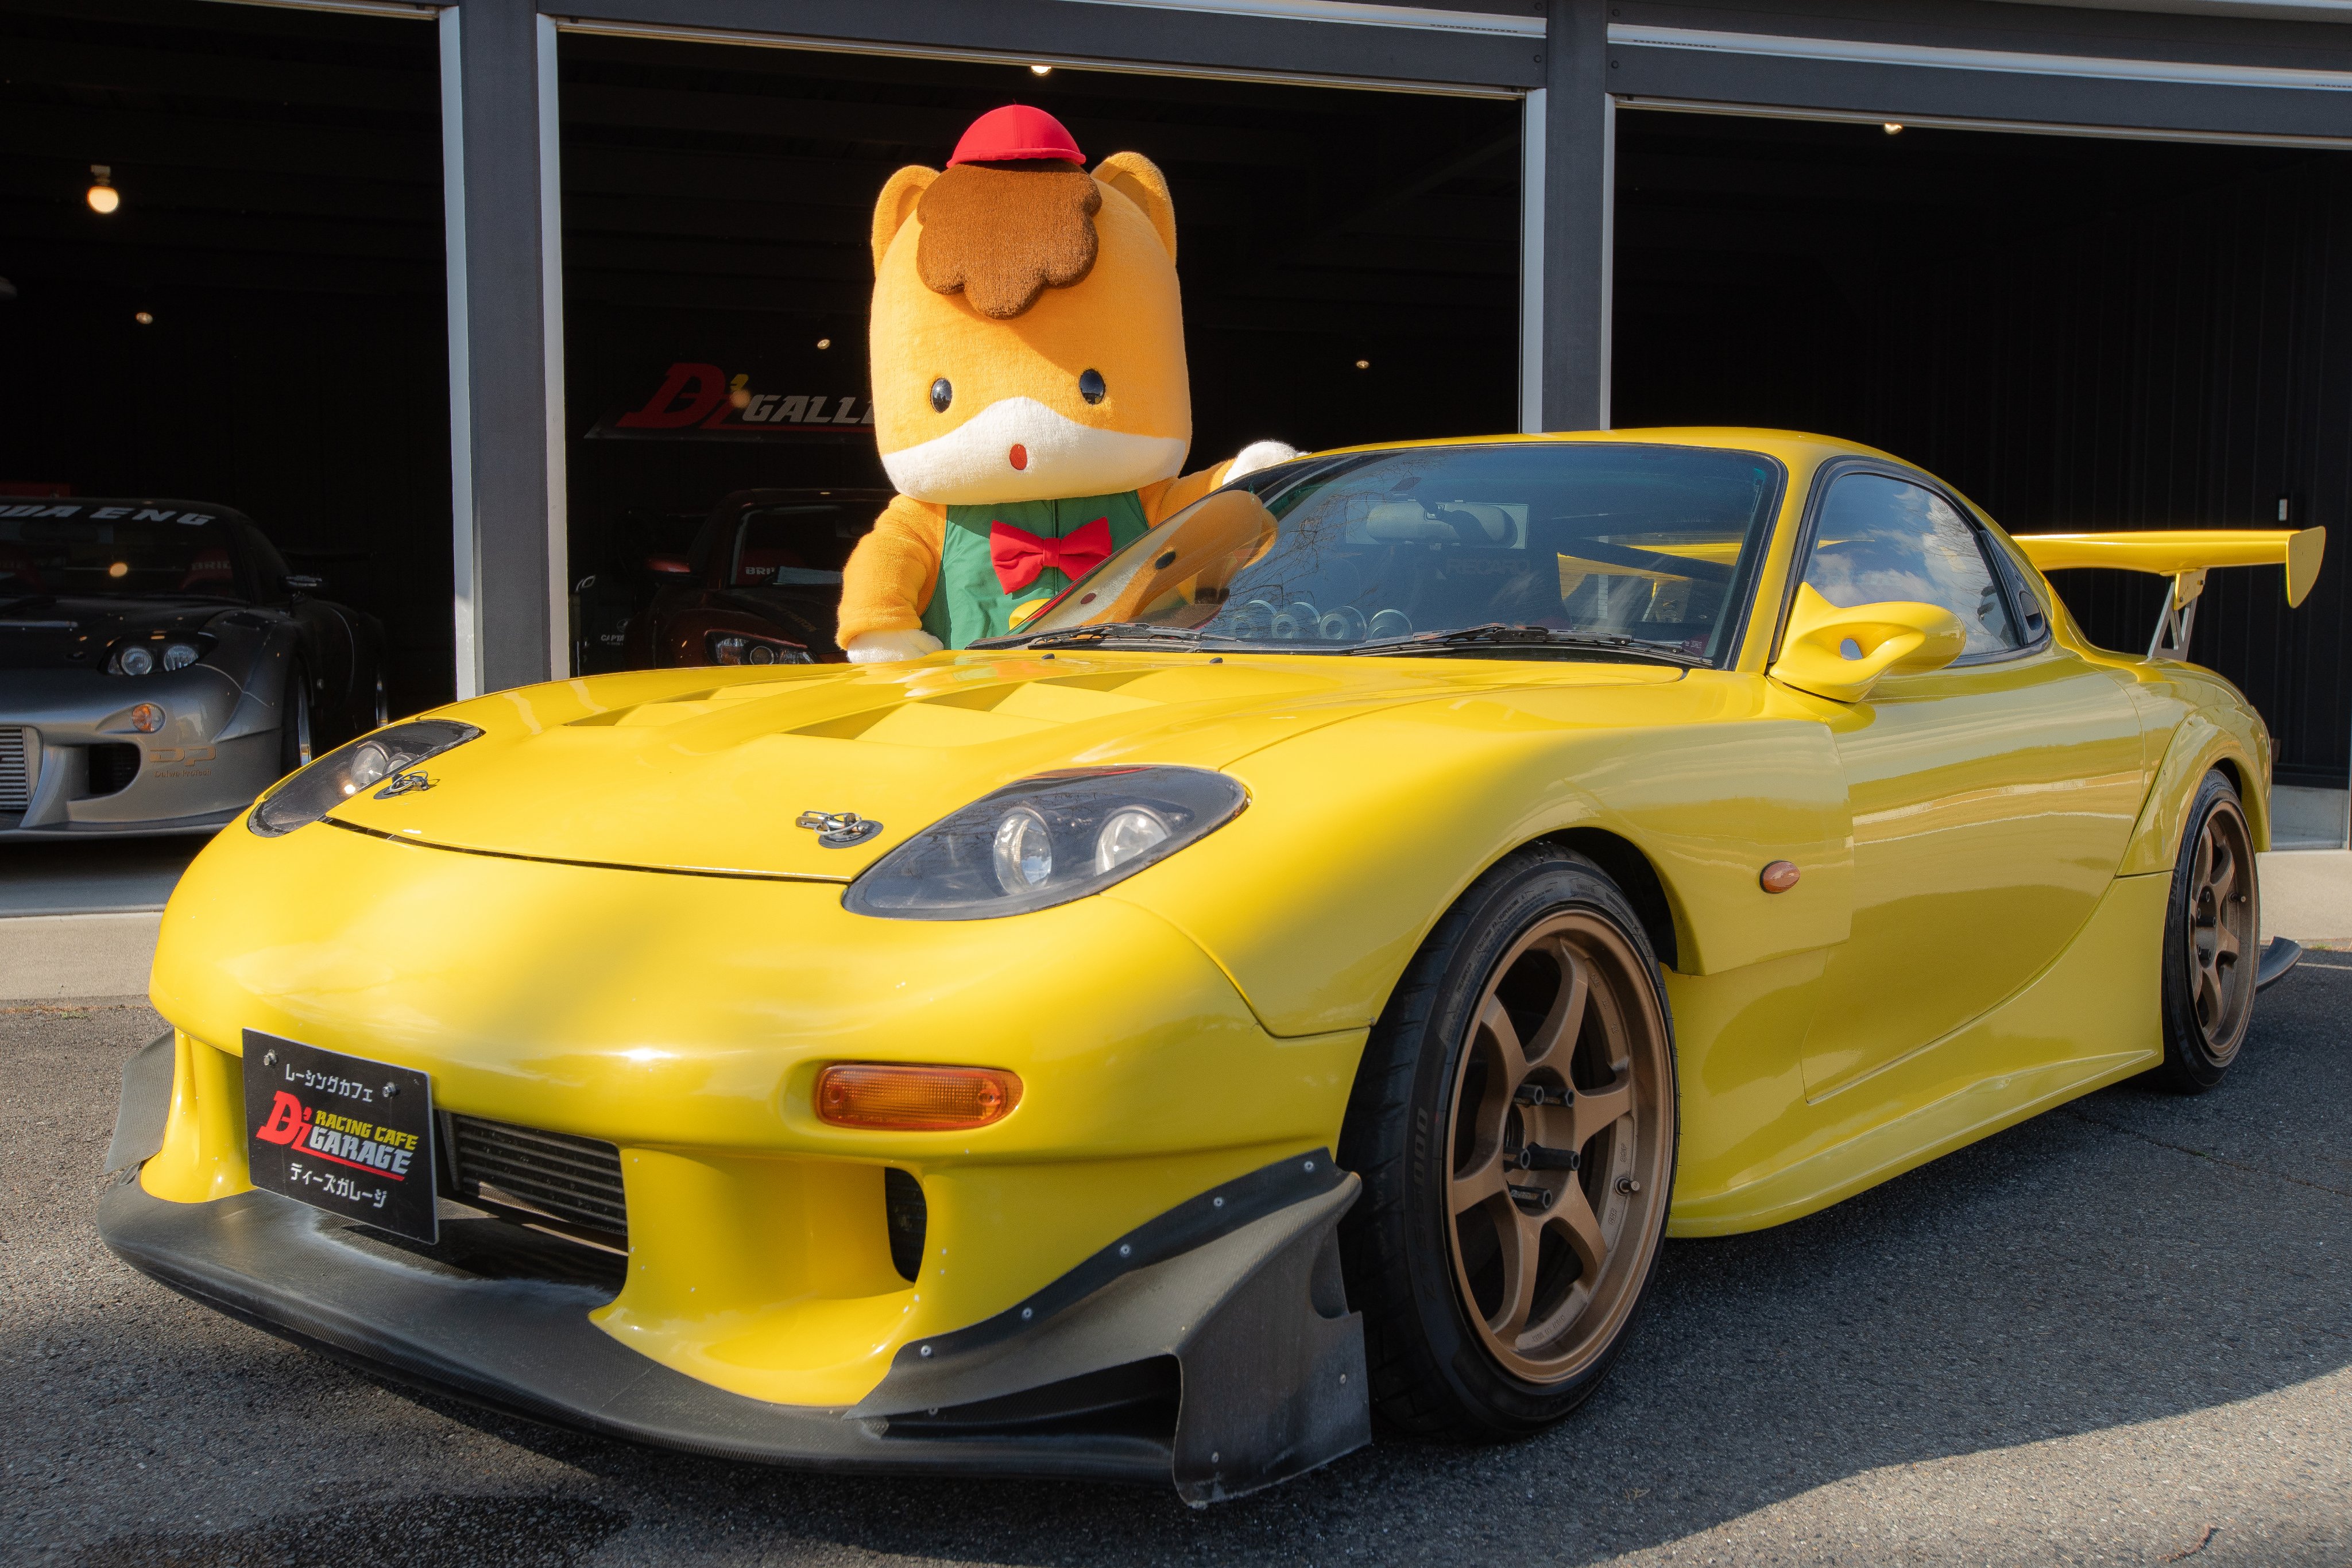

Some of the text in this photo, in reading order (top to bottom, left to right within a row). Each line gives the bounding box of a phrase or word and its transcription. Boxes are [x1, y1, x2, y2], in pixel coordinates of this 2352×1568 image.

[90, 506, 216, 526] ENG
[745, 567, 775, 575] BRI
[1446, 557, 1531, 576] RECARO
[285, 1063, 373, 1102] レーシングカフェ
[315, 1110, 419, 1151] RACING CAFE
[309, 1126, 413, 1175] GARAGE
